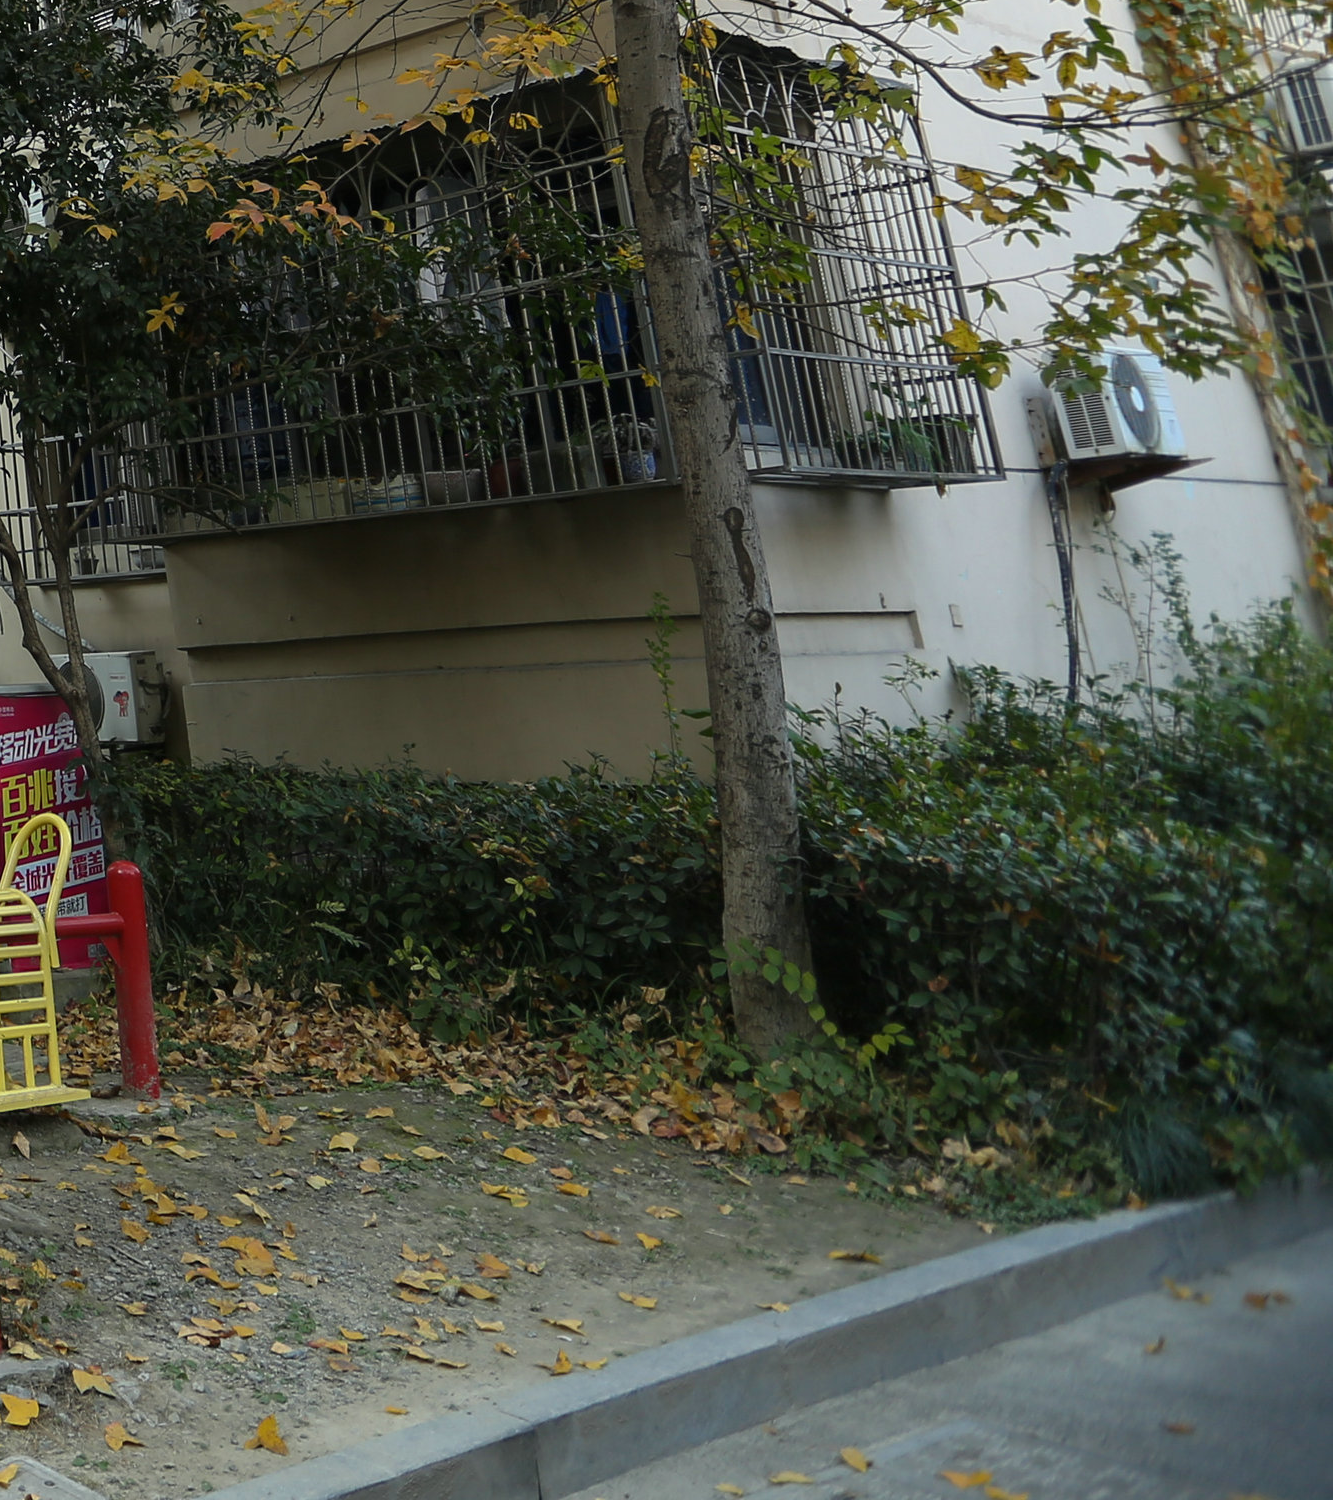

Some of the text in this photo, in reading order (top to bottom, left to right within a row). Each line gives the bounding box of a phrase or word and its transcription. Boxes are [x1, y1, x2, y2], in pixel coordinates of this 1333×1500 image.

[11, 850, 103, 892] 全城光覆盖
